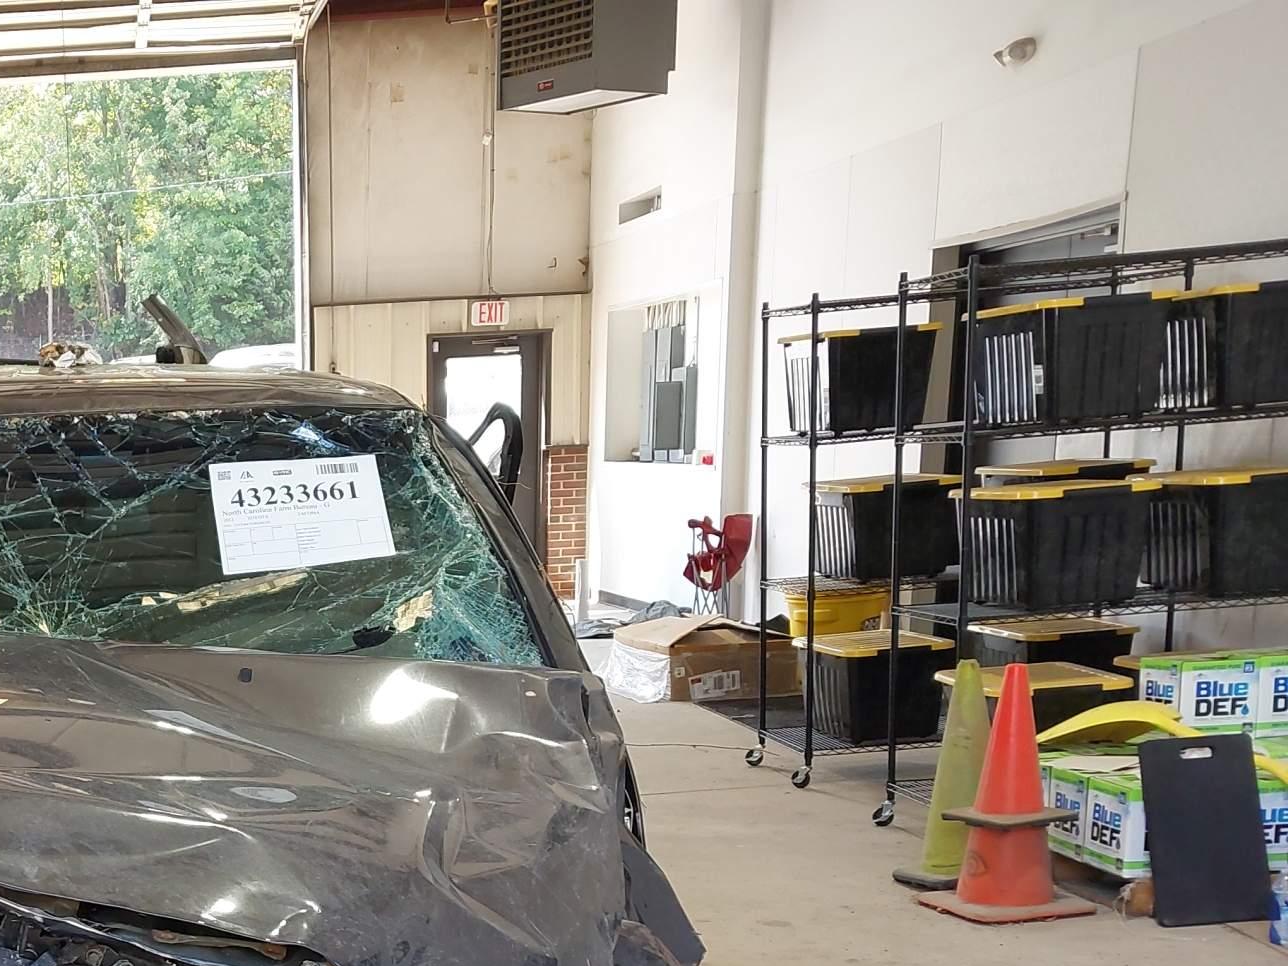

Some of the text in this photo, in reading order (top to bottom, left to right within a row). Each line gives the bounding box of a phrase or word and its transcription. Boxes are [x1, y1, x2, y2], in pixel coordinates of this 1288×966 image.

[479, 302, 505, 323] EXIT
[230, 480, 360, 508] 43233661
[1145, 680, 1174, 698] Blue
[1196, 680, 1249, 697] Blue
[1195, 697, 1248, 717] DEF
[1092, 802, 1122, 828] Blue
[1091, 821, 1121, 847] DEF
